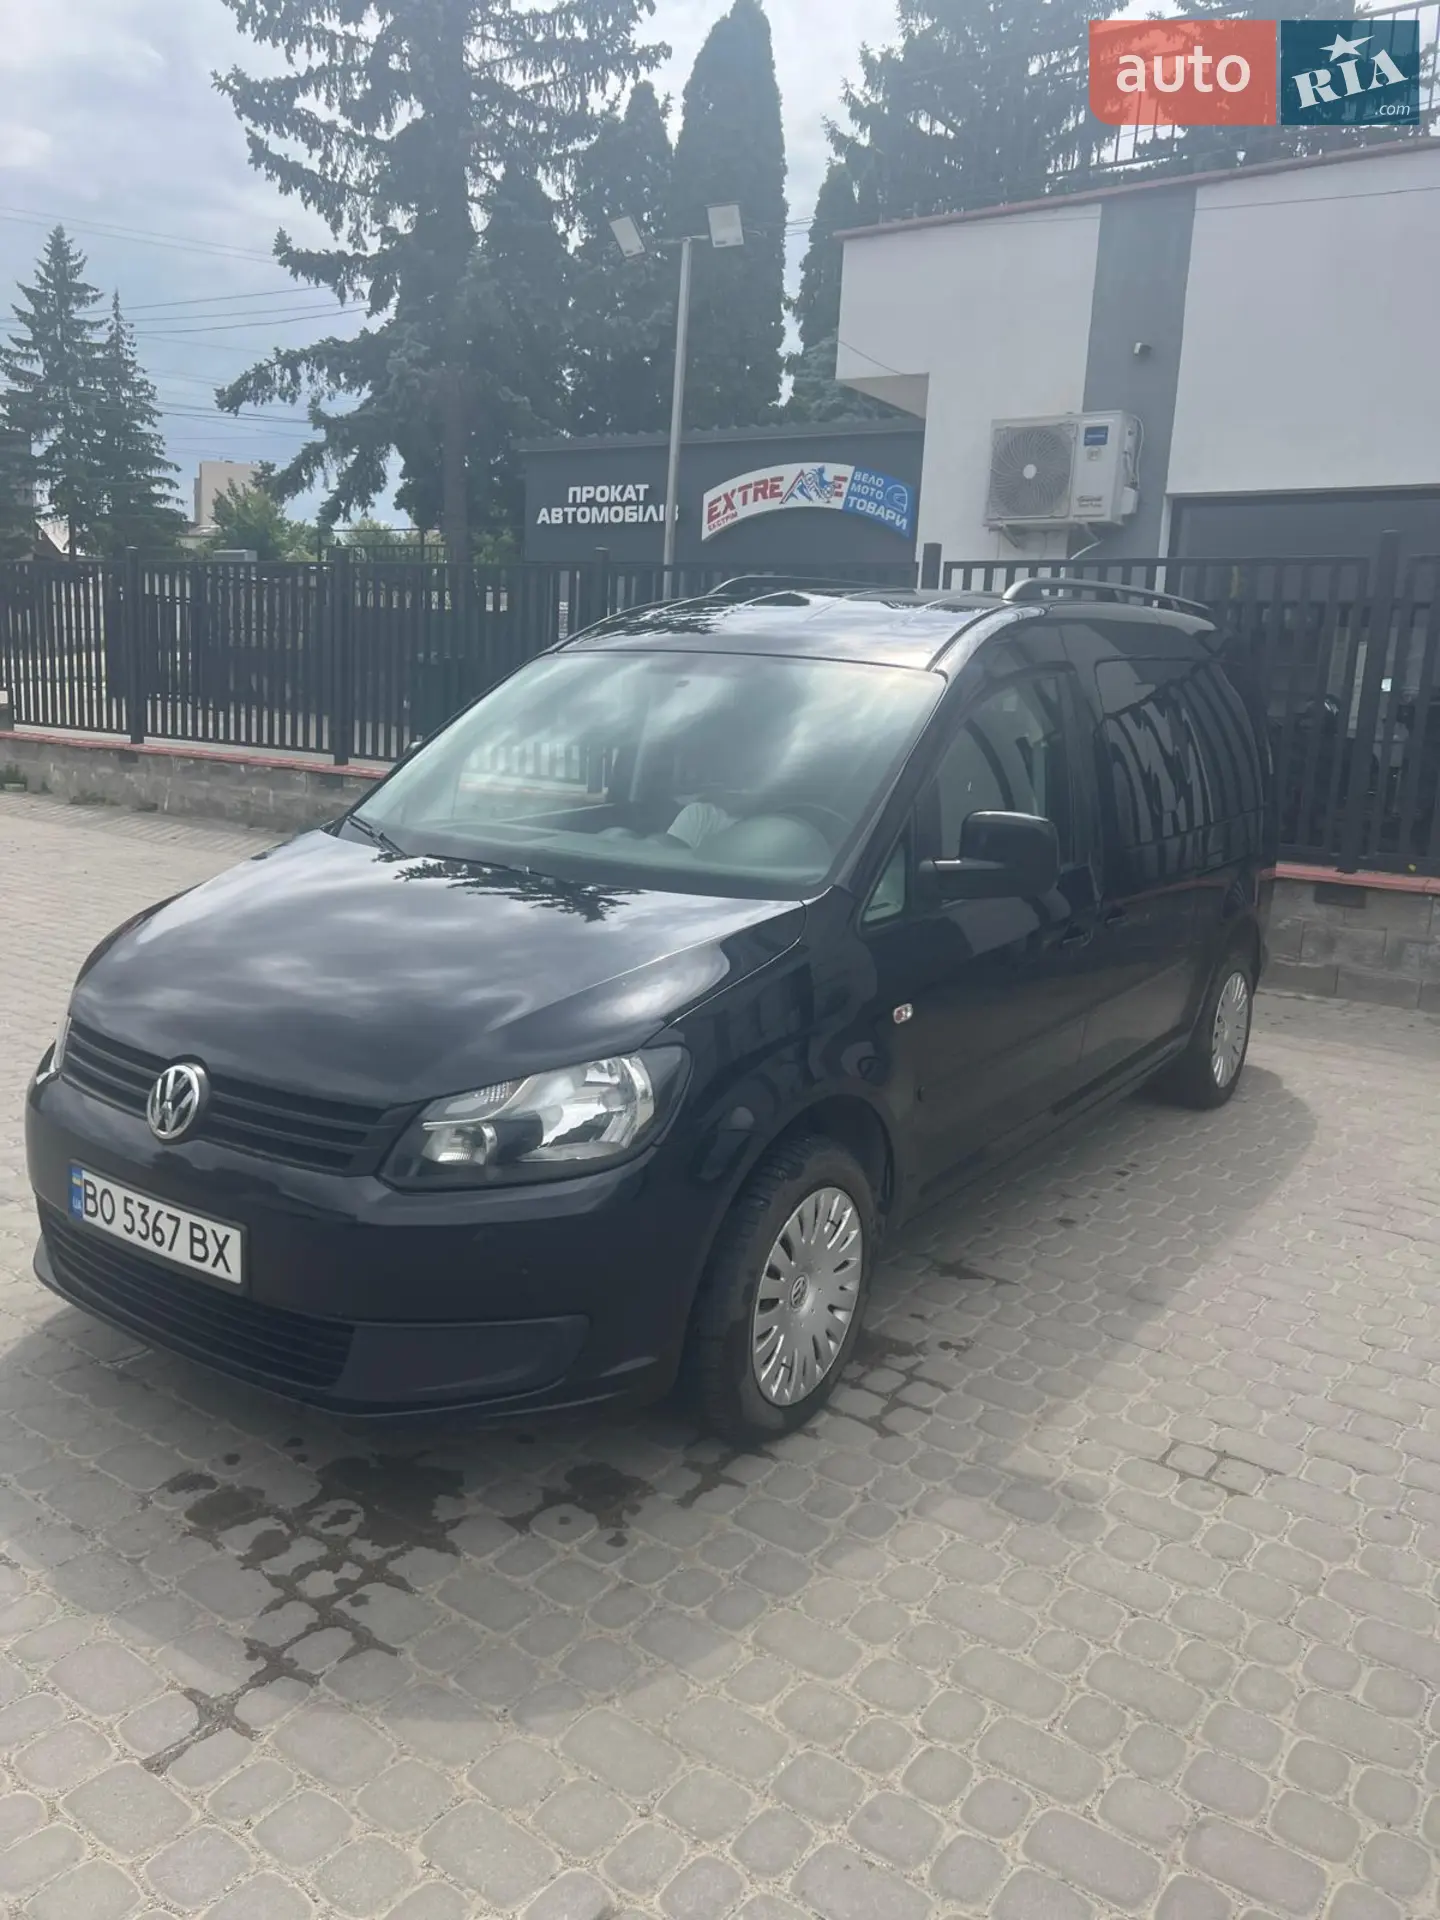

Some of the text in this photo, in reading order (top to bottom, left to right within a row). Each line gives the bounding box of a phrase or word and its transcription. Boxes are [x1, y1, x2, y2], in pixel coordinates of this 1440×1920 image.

[854, 471, 884, 487] ВЕЛО
[568, 484, 649, 503] ПРОКАТ
[851, 483, 884, 499] МОТО
[536, 504, 679, 524] АВТОМОБІЛІ
[847, 496, 907, 530] ТОВАРИ
[83, 1178, 232, 1274] BO 5367 BX
